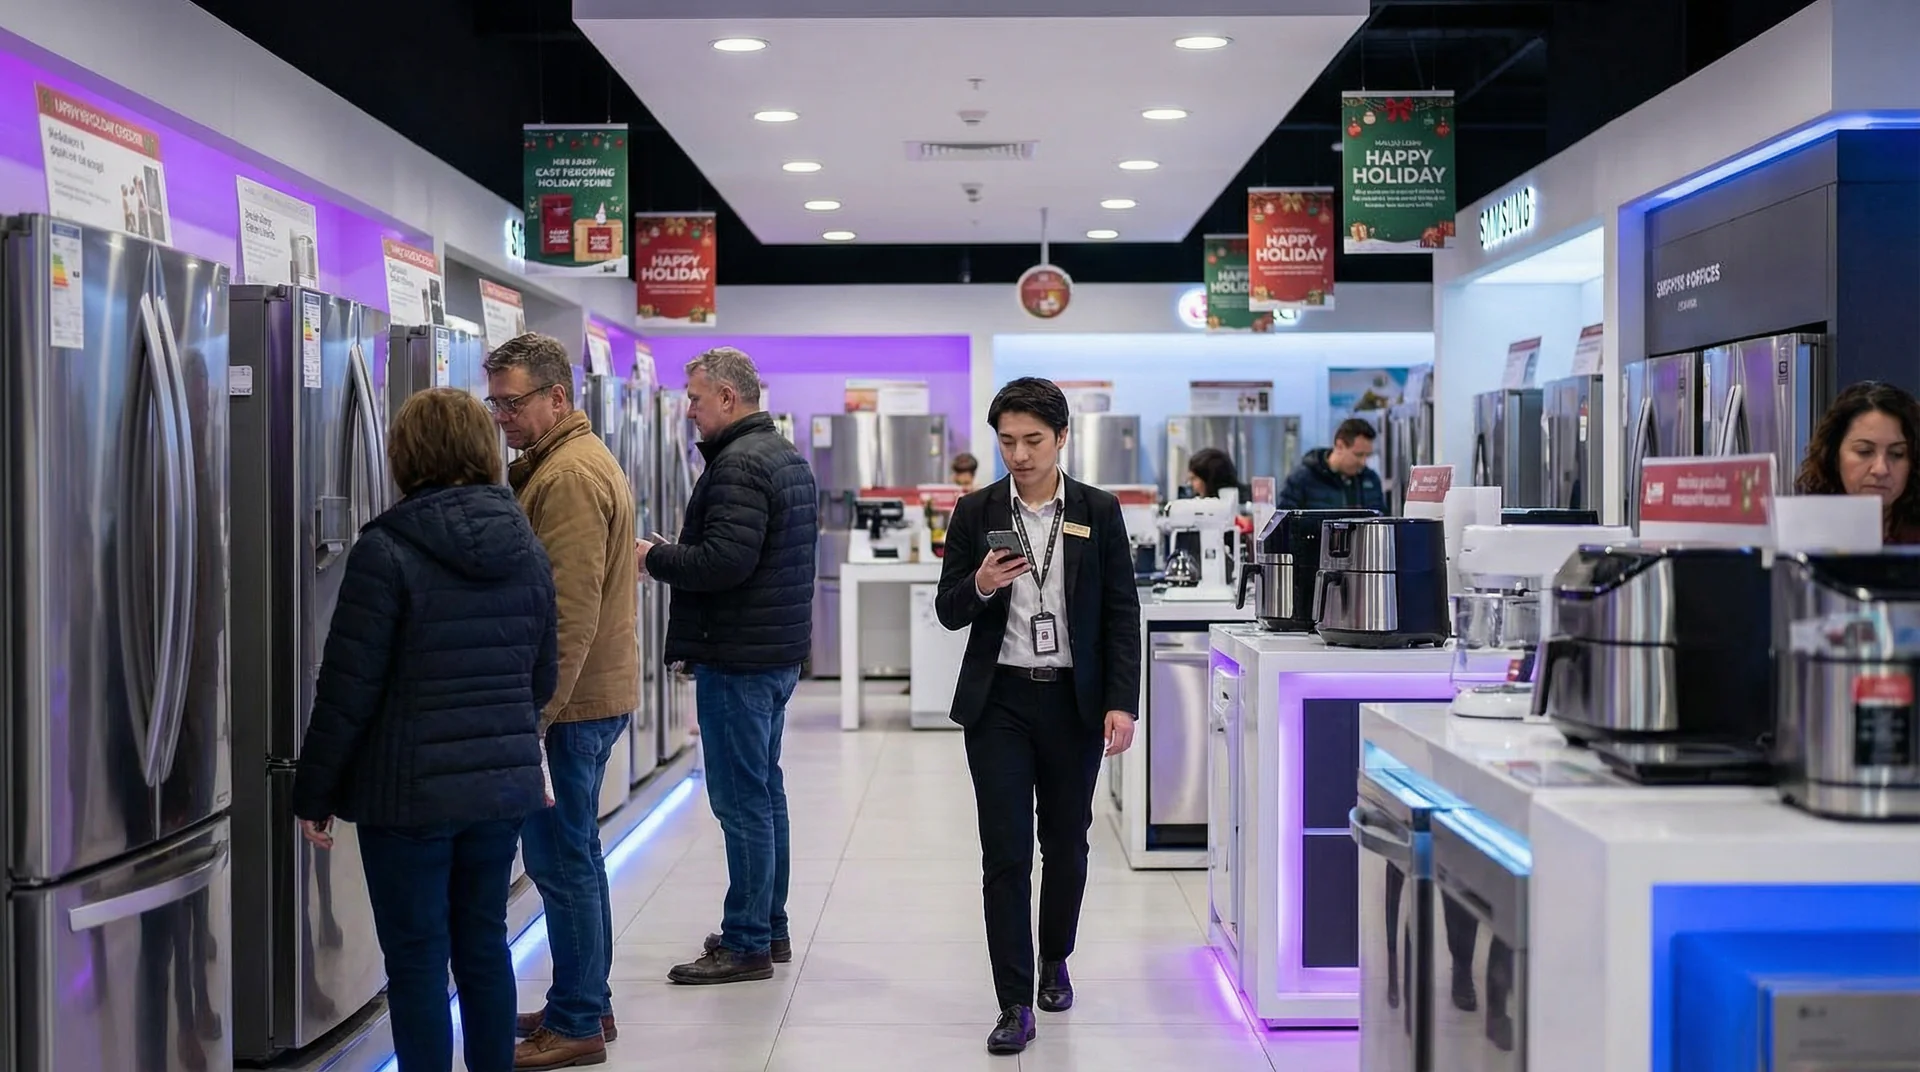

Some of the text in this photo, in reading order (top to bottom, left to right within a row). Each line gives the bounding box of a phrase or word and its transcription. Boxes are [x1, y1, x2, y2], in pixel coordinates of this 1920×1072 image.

[1366, 150, 1433, 165] HAPPY
[1352, 167, 1446, 184] HOLIDAY
[538, 179, 582, 187] HOLIDAY
[1480, 187, 1530, 247] SAMSUNG
[1266, 234, 1317, 247] HAPPY
[651, 255, 701, 267] HAPPY
[1256, 248, 1327, 262] HOLIDAY
[641, 267, 710, 280] HOLIDAY
[1218, 271, 1248, 281] HAP
[1210, 282, 1248, 293] HOLID
